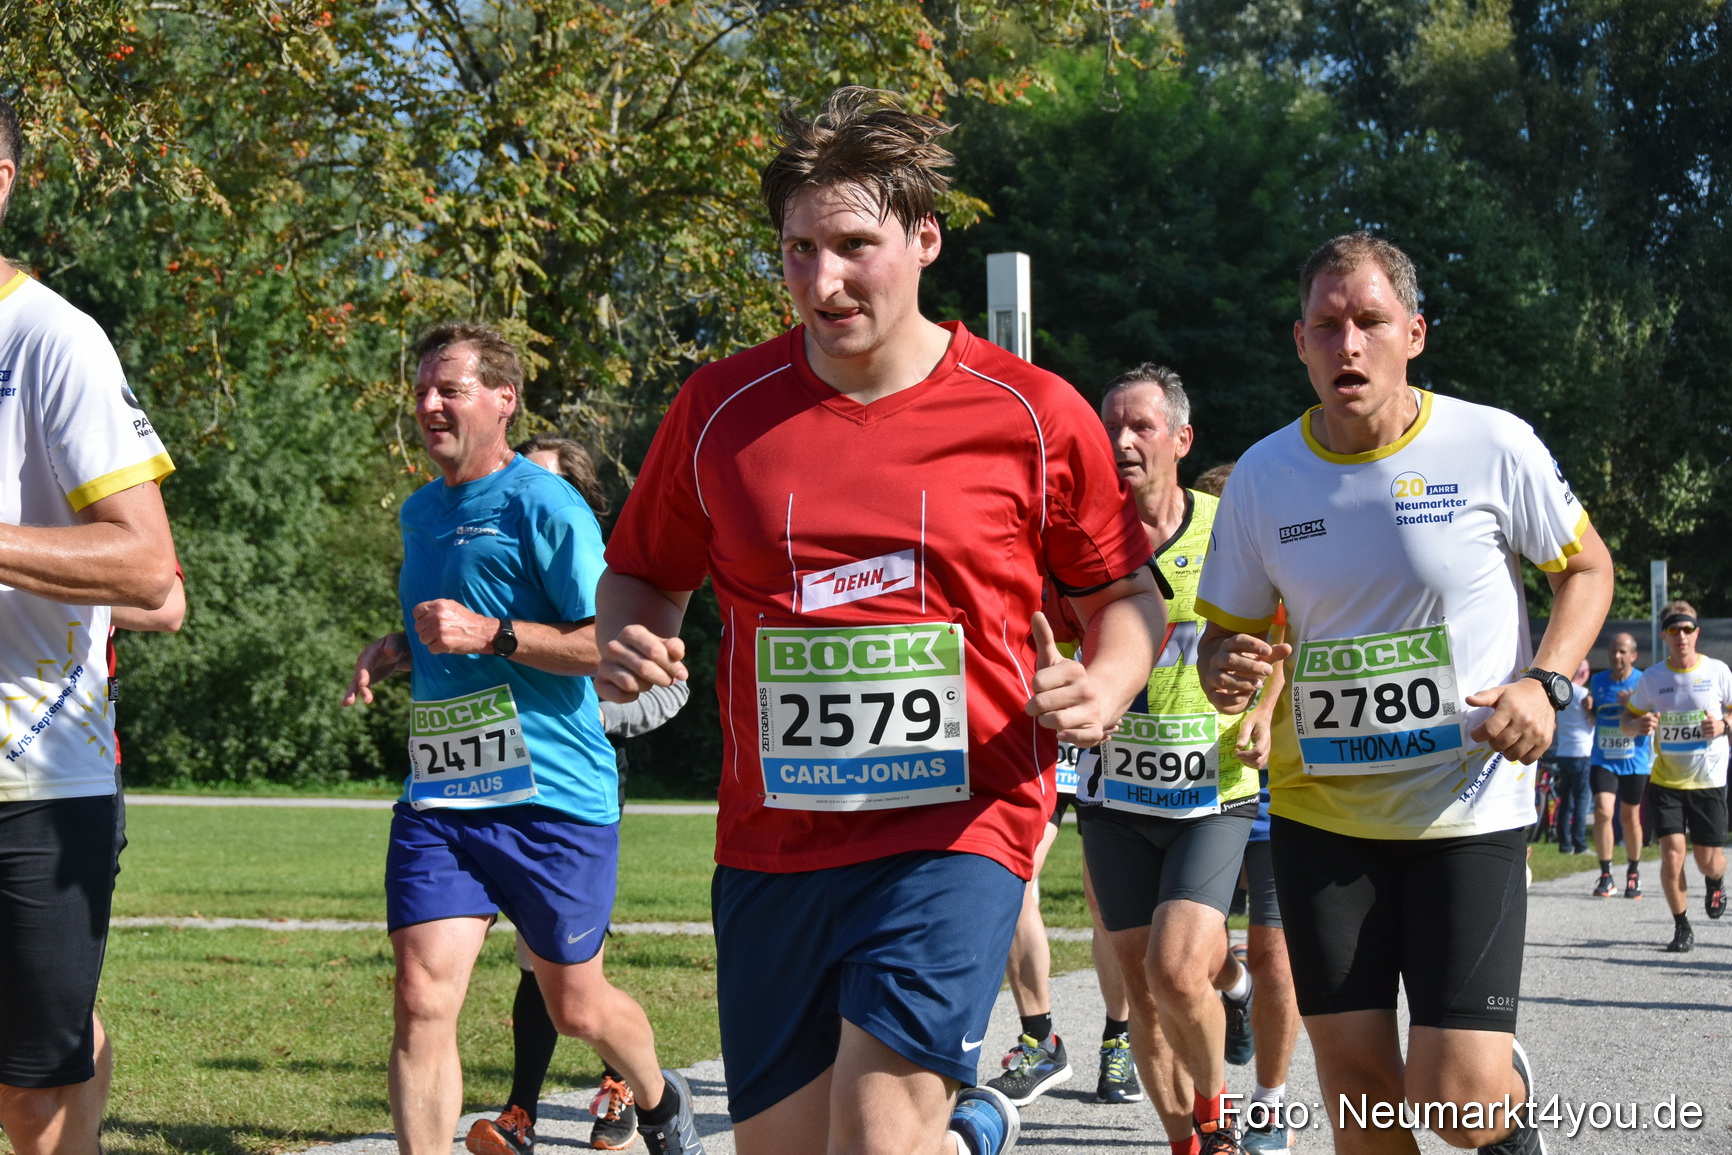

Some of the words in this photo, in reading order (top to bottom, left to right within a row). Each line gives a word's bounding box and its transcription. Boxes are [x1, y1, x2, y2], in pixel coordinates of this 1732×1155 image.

[1395, 478, 1424, 498] 20
[1429, 485, 1456, 495] JAHRE
[1395, 498, 1467, 512] Neumarkter
[1279, 519, 1326, 540] BOCK
[1396, 511, 1454, 526] Stadtlauf
[833, 567, 884, 595] DEHN
[772, 632, 941, 674] BOCK
[1306, 635, 1435, 675] BOCK
[945, 690, 956, 701] C
[1309, 677, 1440, 729] 2780
[6, 734, 35, 763] 14./15.
[31, 686, 73, 735] September
[416, 694, 504, 732] BOCK
[780, 688, 941, 748] 2579
[509, 728, 516, 736] B
[1662, 726, 1701, 741] 2764
[419, 729, 506, 774] 2477
[1330, 729, 1436, 762] THOMAS
[780, 758, 947, 784] CARL-JONAS
[1115, 747, 1206, 783] 2690
[443, 776, 504, 797] CLAUS
[1127, 785, 1199, 807] HELMUTH
[1459, 779, 1485, 803] 14./15.
[1487, 996, 1515, 1007] GORE
